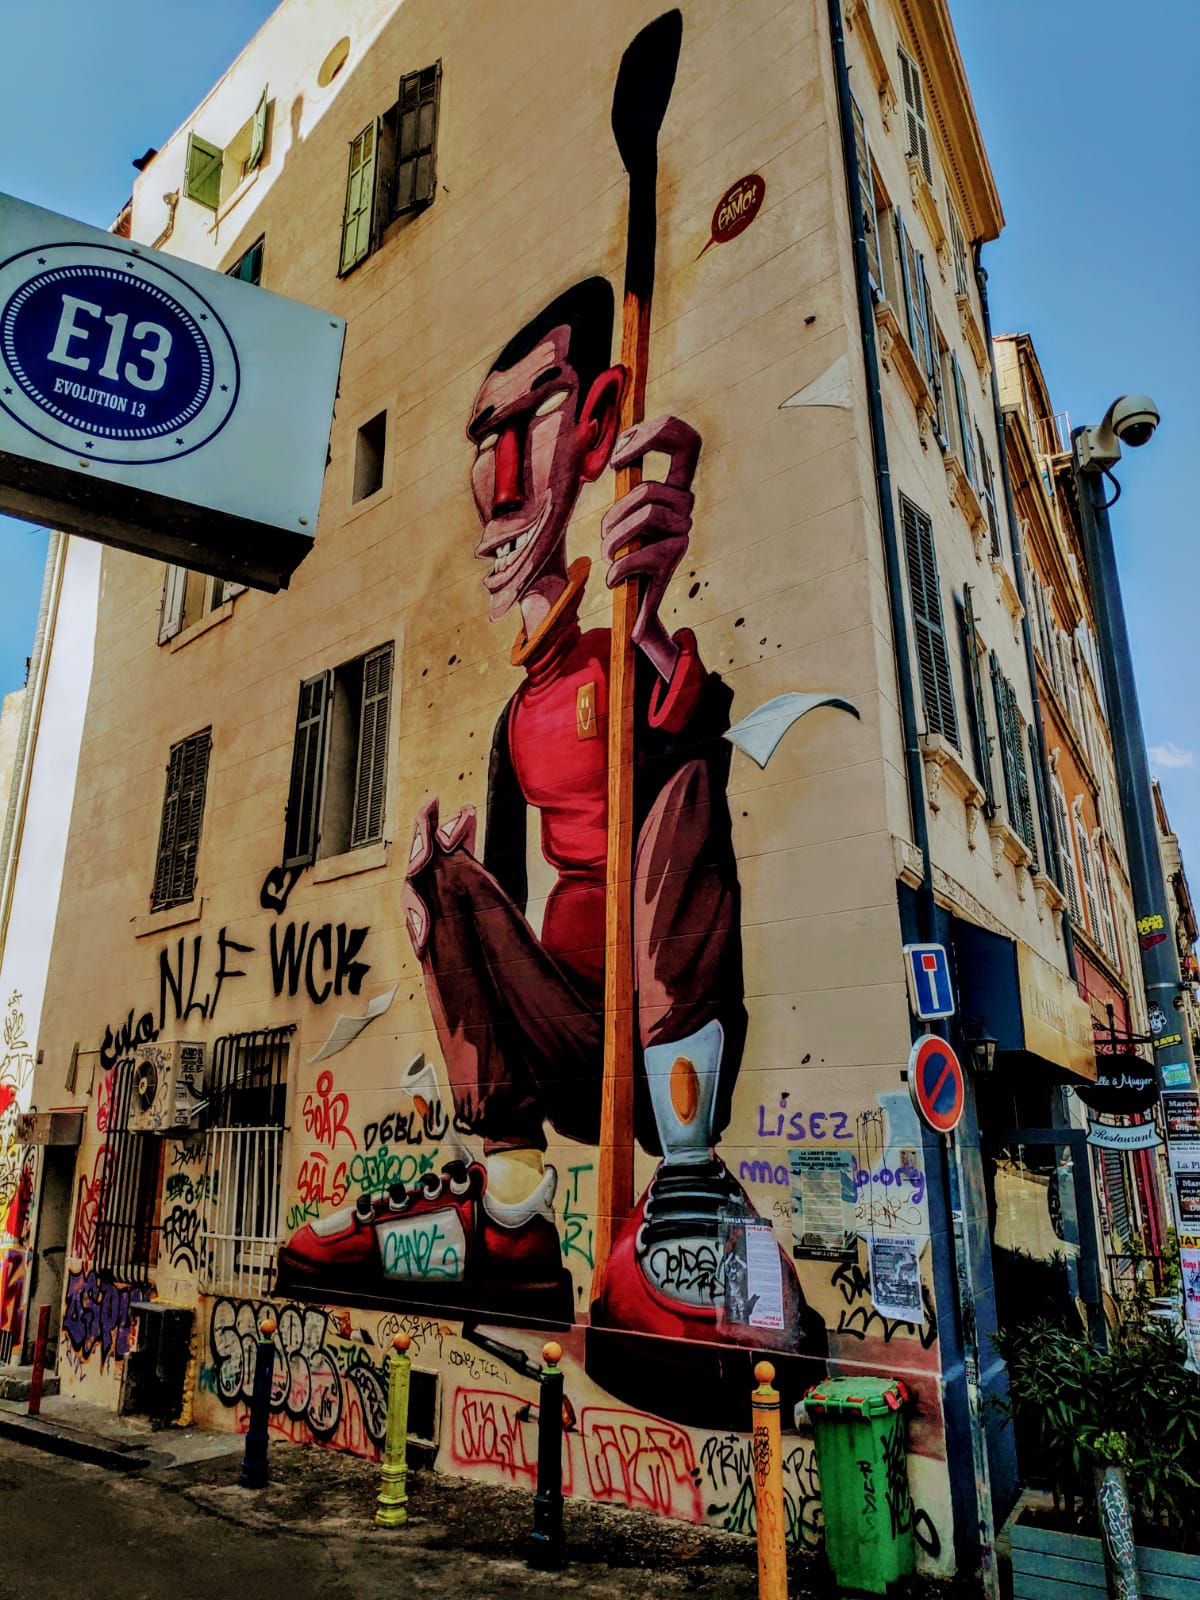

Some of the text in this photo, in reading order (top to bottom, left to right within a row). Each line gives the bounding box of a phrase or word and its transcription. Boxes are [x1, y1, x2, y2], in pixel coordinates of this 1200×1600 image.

[47, 294, 173, 392] E13
[53, 377, 146, 418] EVOLUTION 13
[1094, 1129, 1153, 1143] Restaurant
[1177, 1161, 1188, 1169] La
